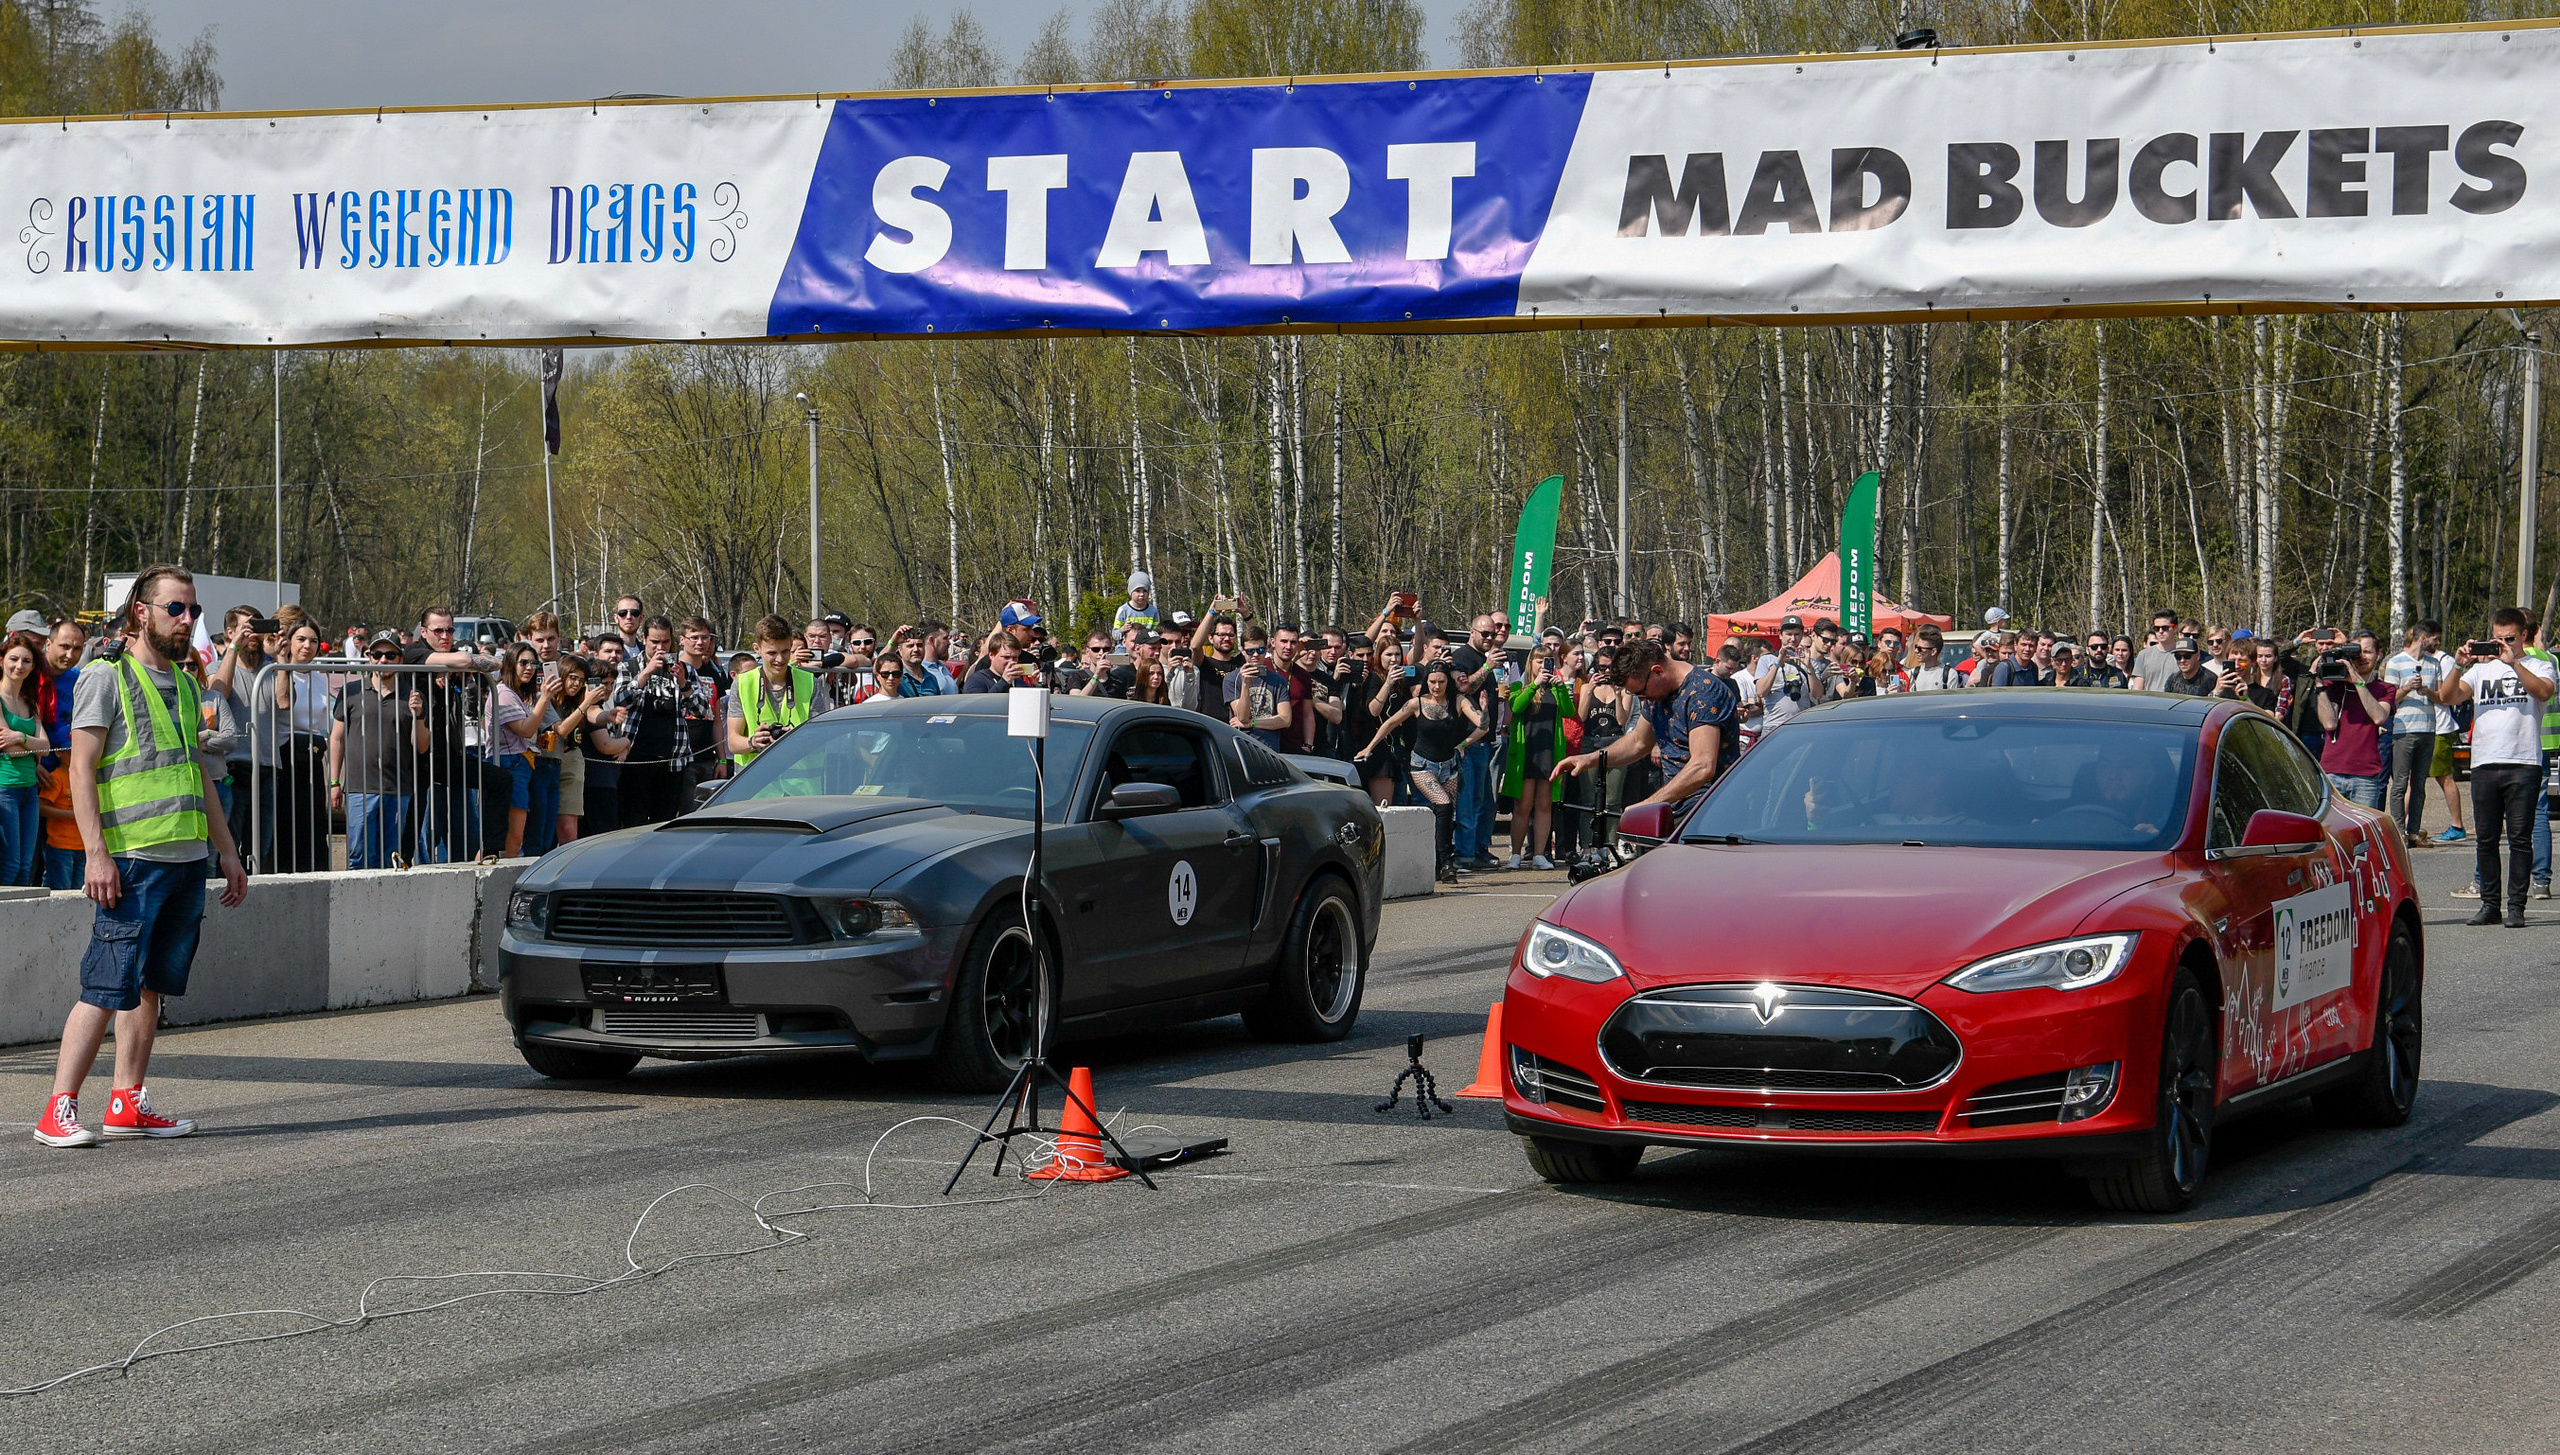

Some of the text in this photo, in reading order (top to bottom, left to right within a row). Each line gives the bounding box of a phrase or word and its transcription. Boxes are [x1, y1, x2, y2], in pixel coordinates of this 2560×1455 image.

[1617, 119, 2527, 238] MAD BUCKETS
[63, 182, 697, 273] RUSSIAN WEEKEND DRAGS
[863, 140, 1477, 275] START
[1516, 551, 1534, 636] REEDOM
[1524, 592, 1536, 634] ance
[1849, 548, 1859, 634] EEDOM
[2496, 697, 2528, 705] BUCKETS
[1174, 873, 1191, 903] 14
[2280, 926, 2291, 961] 12
[2299, 907, 2350, 955] FREEDOM
[2298, 957, 2326, 984] finance
